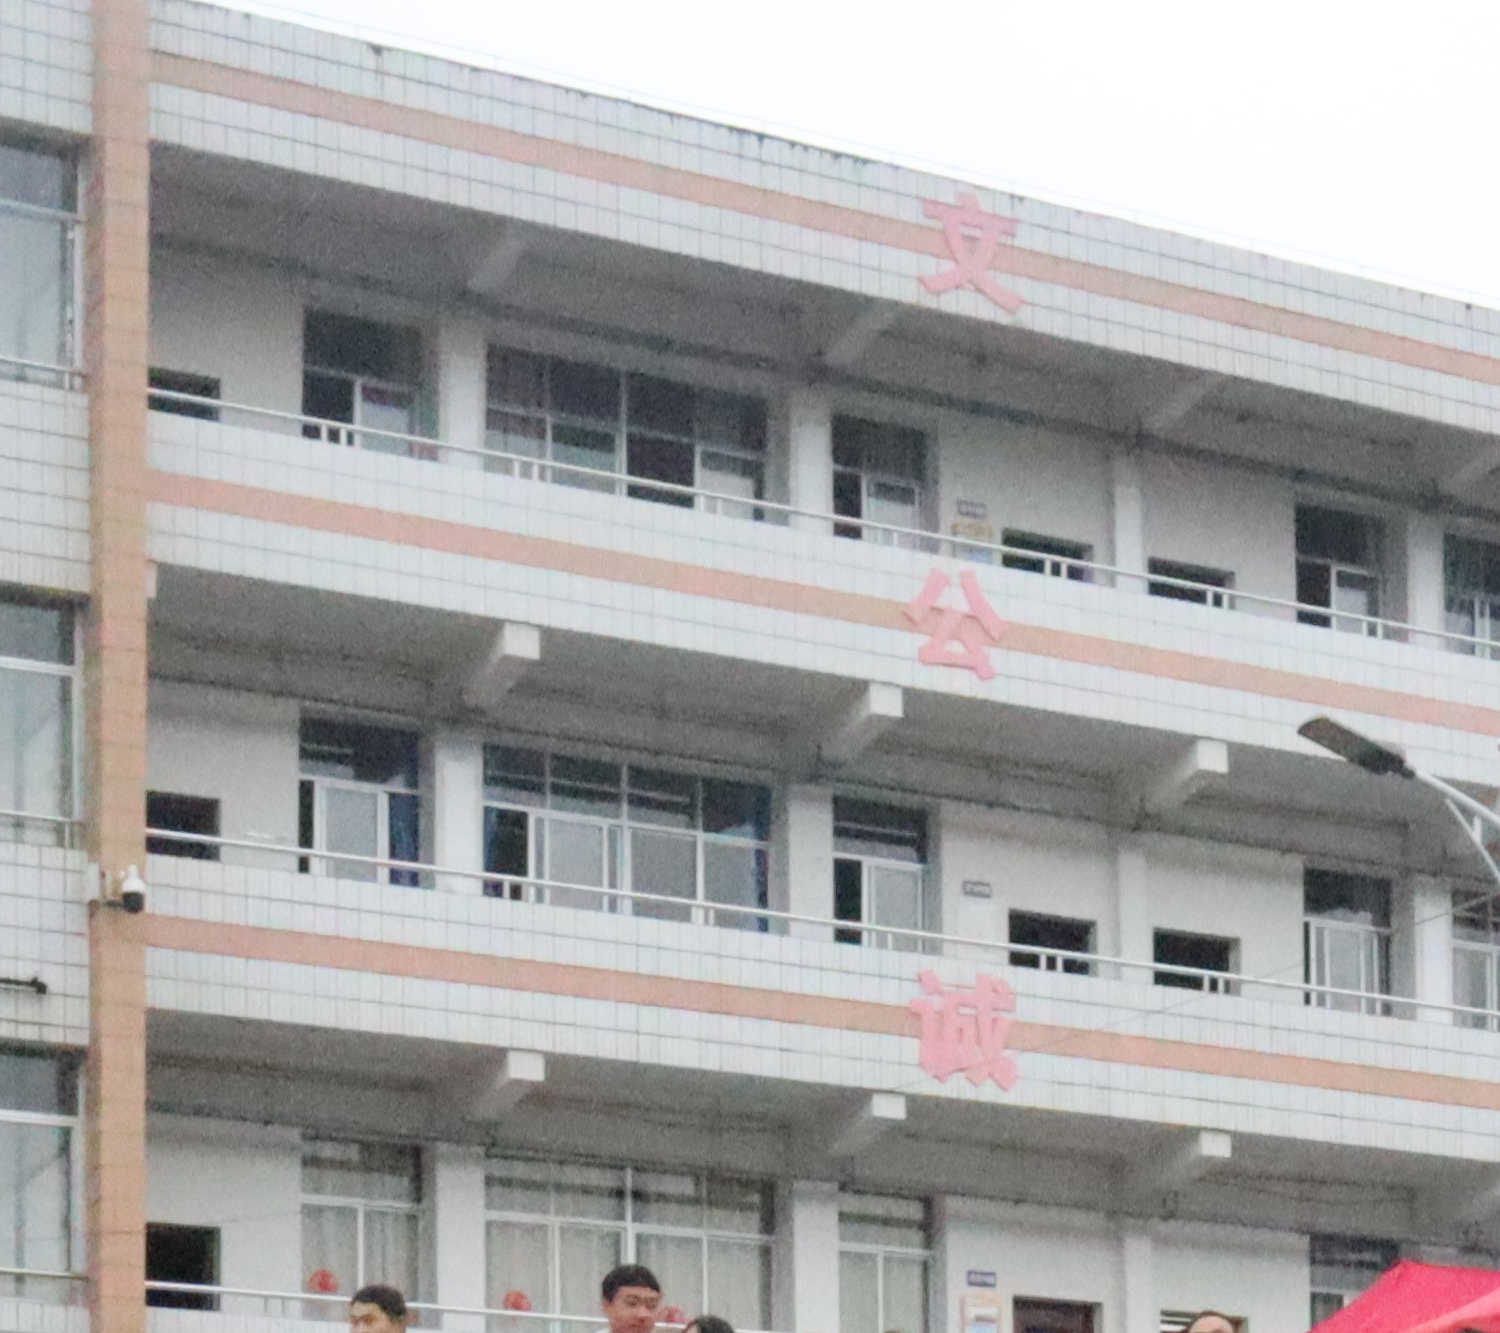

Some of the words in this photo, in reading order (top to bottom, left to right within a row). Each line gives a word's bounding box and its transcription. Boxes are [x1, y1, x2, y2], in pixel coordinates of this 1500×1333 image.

[916, 190, 1024, 313] 文
[904, 568, 1008, 681] 公
[910, 968, 1018, 1092] 诚
